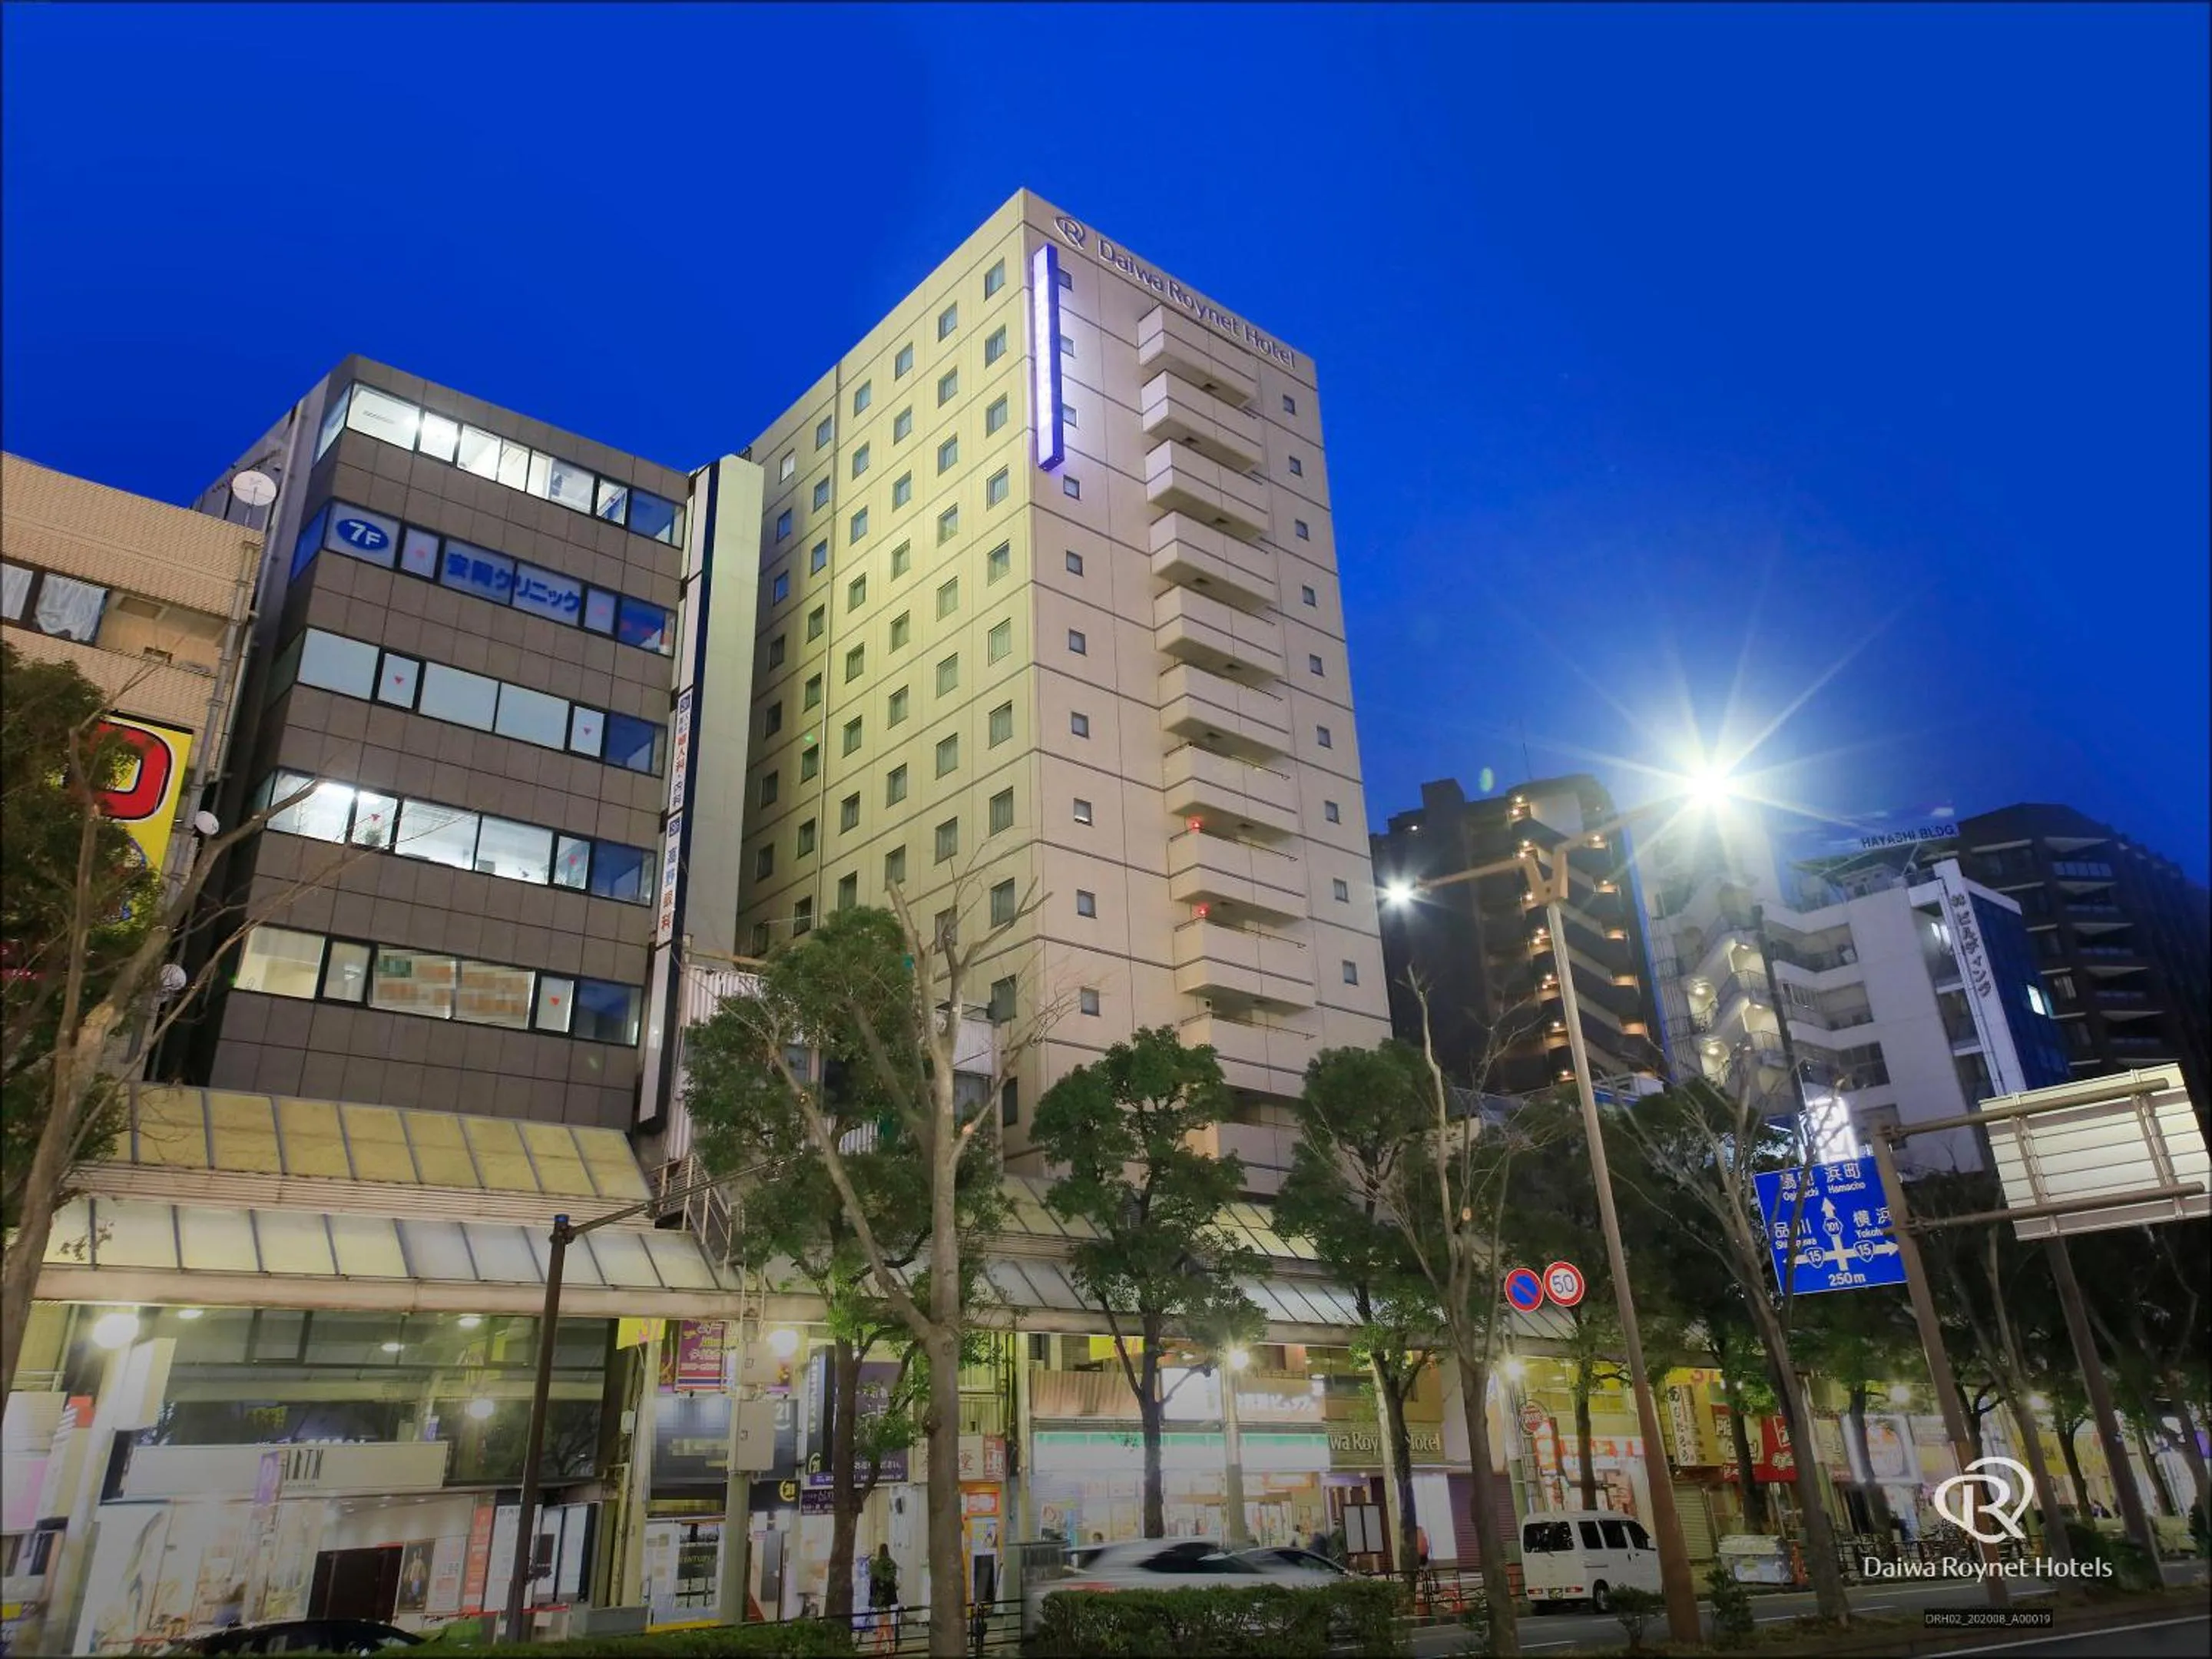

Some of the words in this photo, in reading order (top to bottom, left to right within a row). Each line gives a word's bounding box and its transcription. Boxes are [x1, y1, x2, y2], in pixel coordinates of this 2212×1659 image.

[1097, 238, 1164, 293] Daiwa
[1167, 279, 1240, 338] Roynet
[1243, 323, 1296, 370] Hotel
[346, 520, 381, 546] 7F
[1860, 829, 1917, 849] HAYASHI
[1824, 1163, 1861, 1184] 浜町
[1827, 1181, 1866, 1194] Hamacho
[1853, 1206, 1892, 1228] 横浜
[1809, 1249, 1822, 1263] 15
[1859, 1242, 1872, 1257] 15
[1552, 1273, 1575, 1294] 50
